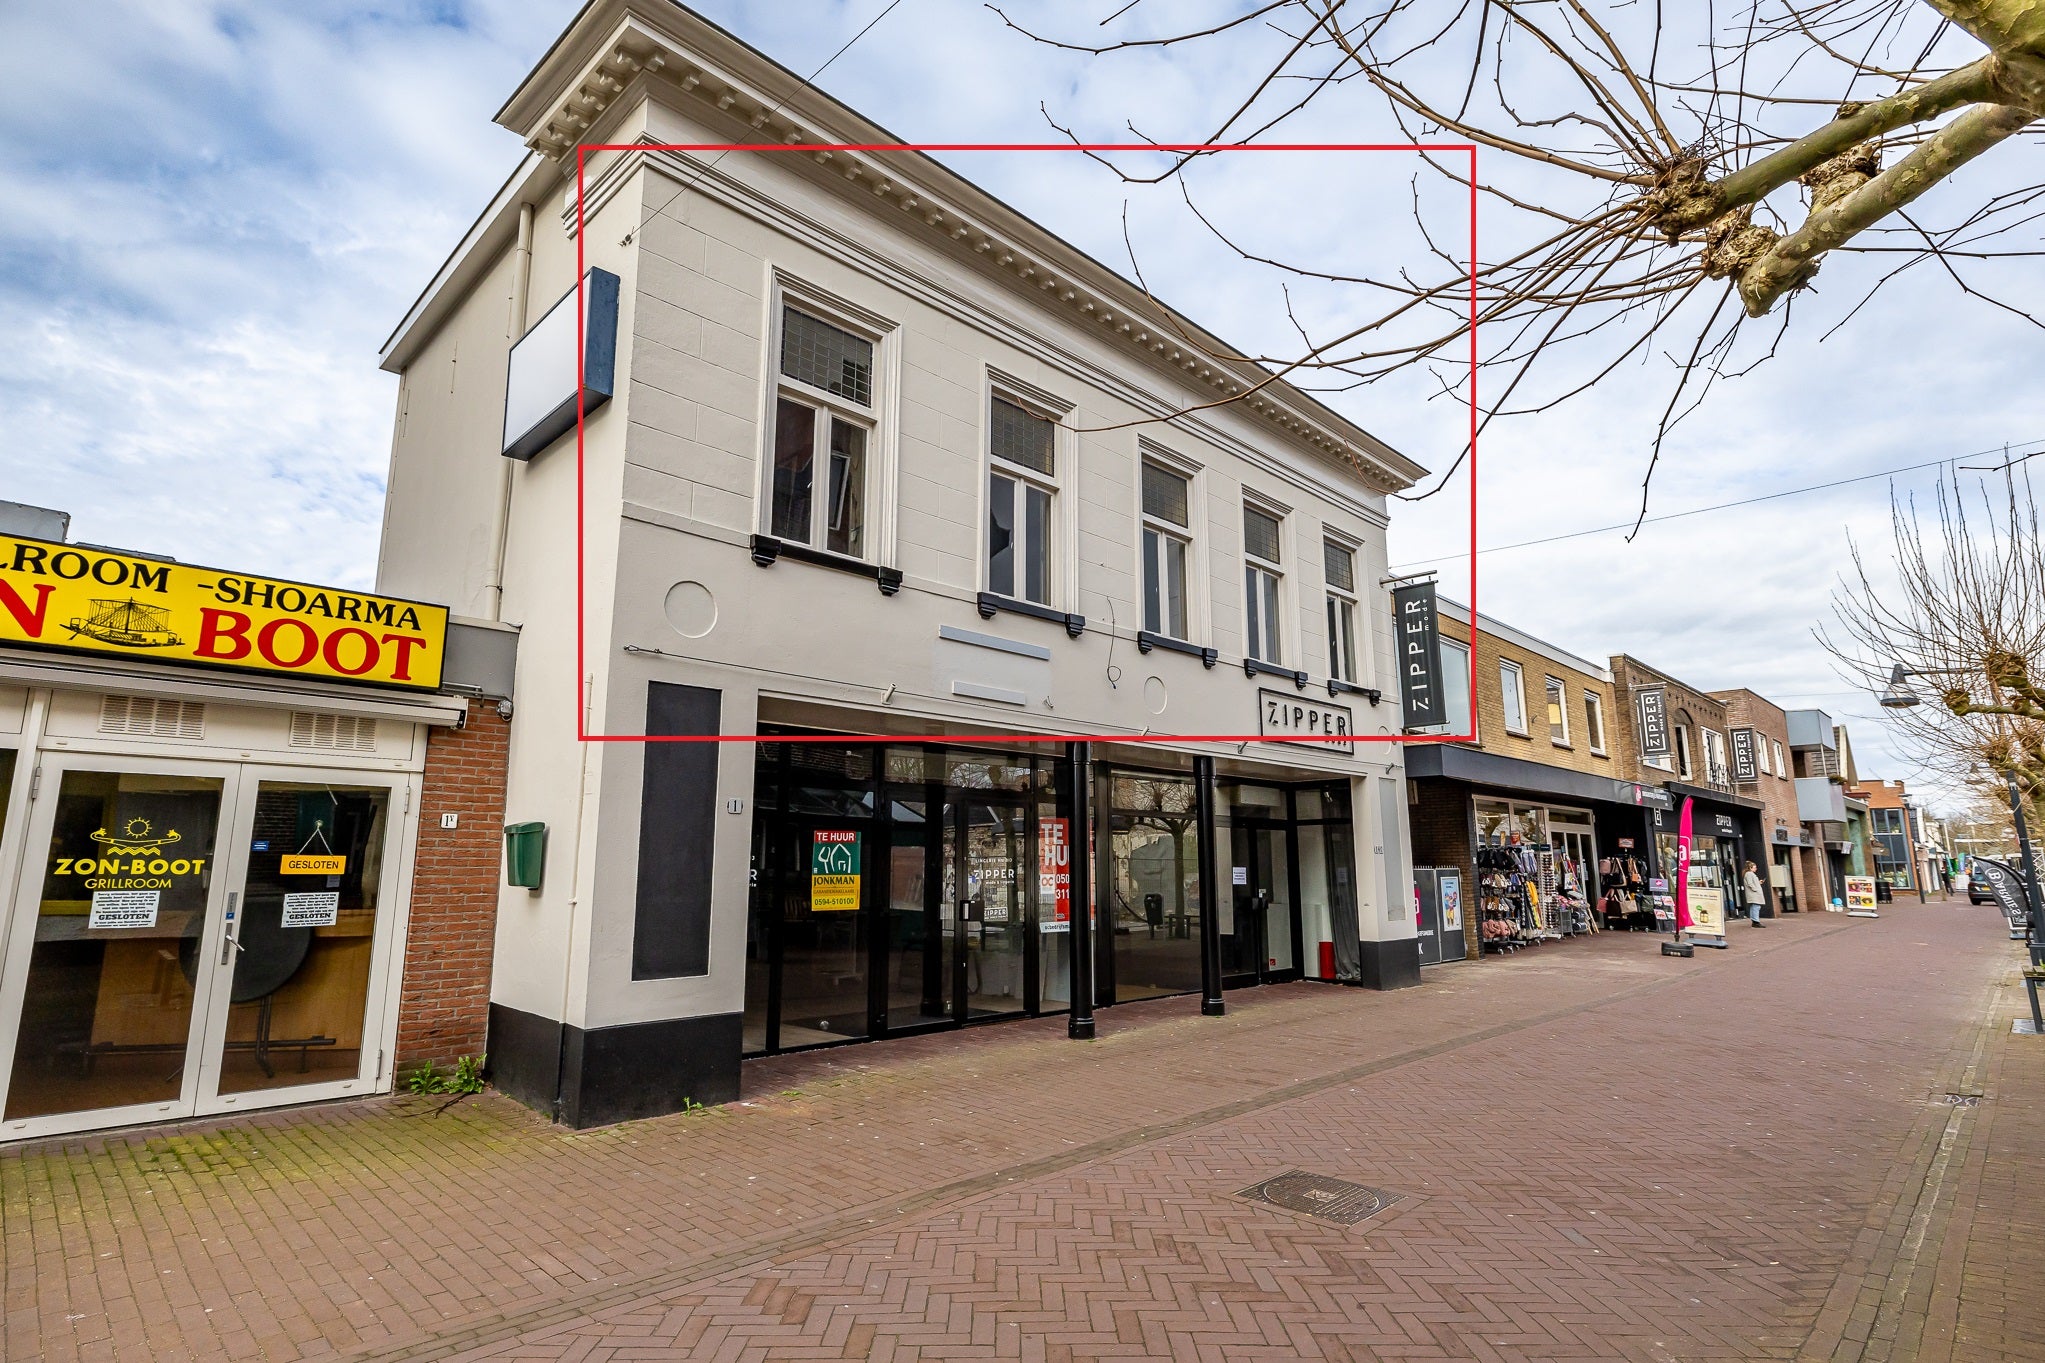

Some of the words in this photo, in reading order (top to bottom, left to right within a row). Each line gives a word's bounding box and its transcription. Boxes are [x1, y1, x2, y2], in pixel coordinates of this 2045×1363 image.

[0, 543, 172, 593] ROOM
[193, 607, 427, 681] BOOT
[1405, 600, 1430, 711] ZIPPER
[1268, 701, 1347, 738] ZIPPER
[1644, 696, 1661, 747] ZIPPER
[1737, 734, 1750, 775] ZIPPER
[816, 832, 828, 841] TE
[830, 833, 855, 842] HUUR
[1041, 823, 1064, 845] TE
[54, 858, 205, 875] ZON-BOOT
[288, 860, 339, 869] GESLOTEN
[814, 876, 855, 887] JONKMAN
[973, 869, 1015, 880] ZIPPER
[84, 878, 172, 889] GRILLROOM
[815, 898, 854, 906] 0594-510100
[98, 913, 150, 921] GESLOTEN
[289, 912, 331, 920] GESLOTEN
